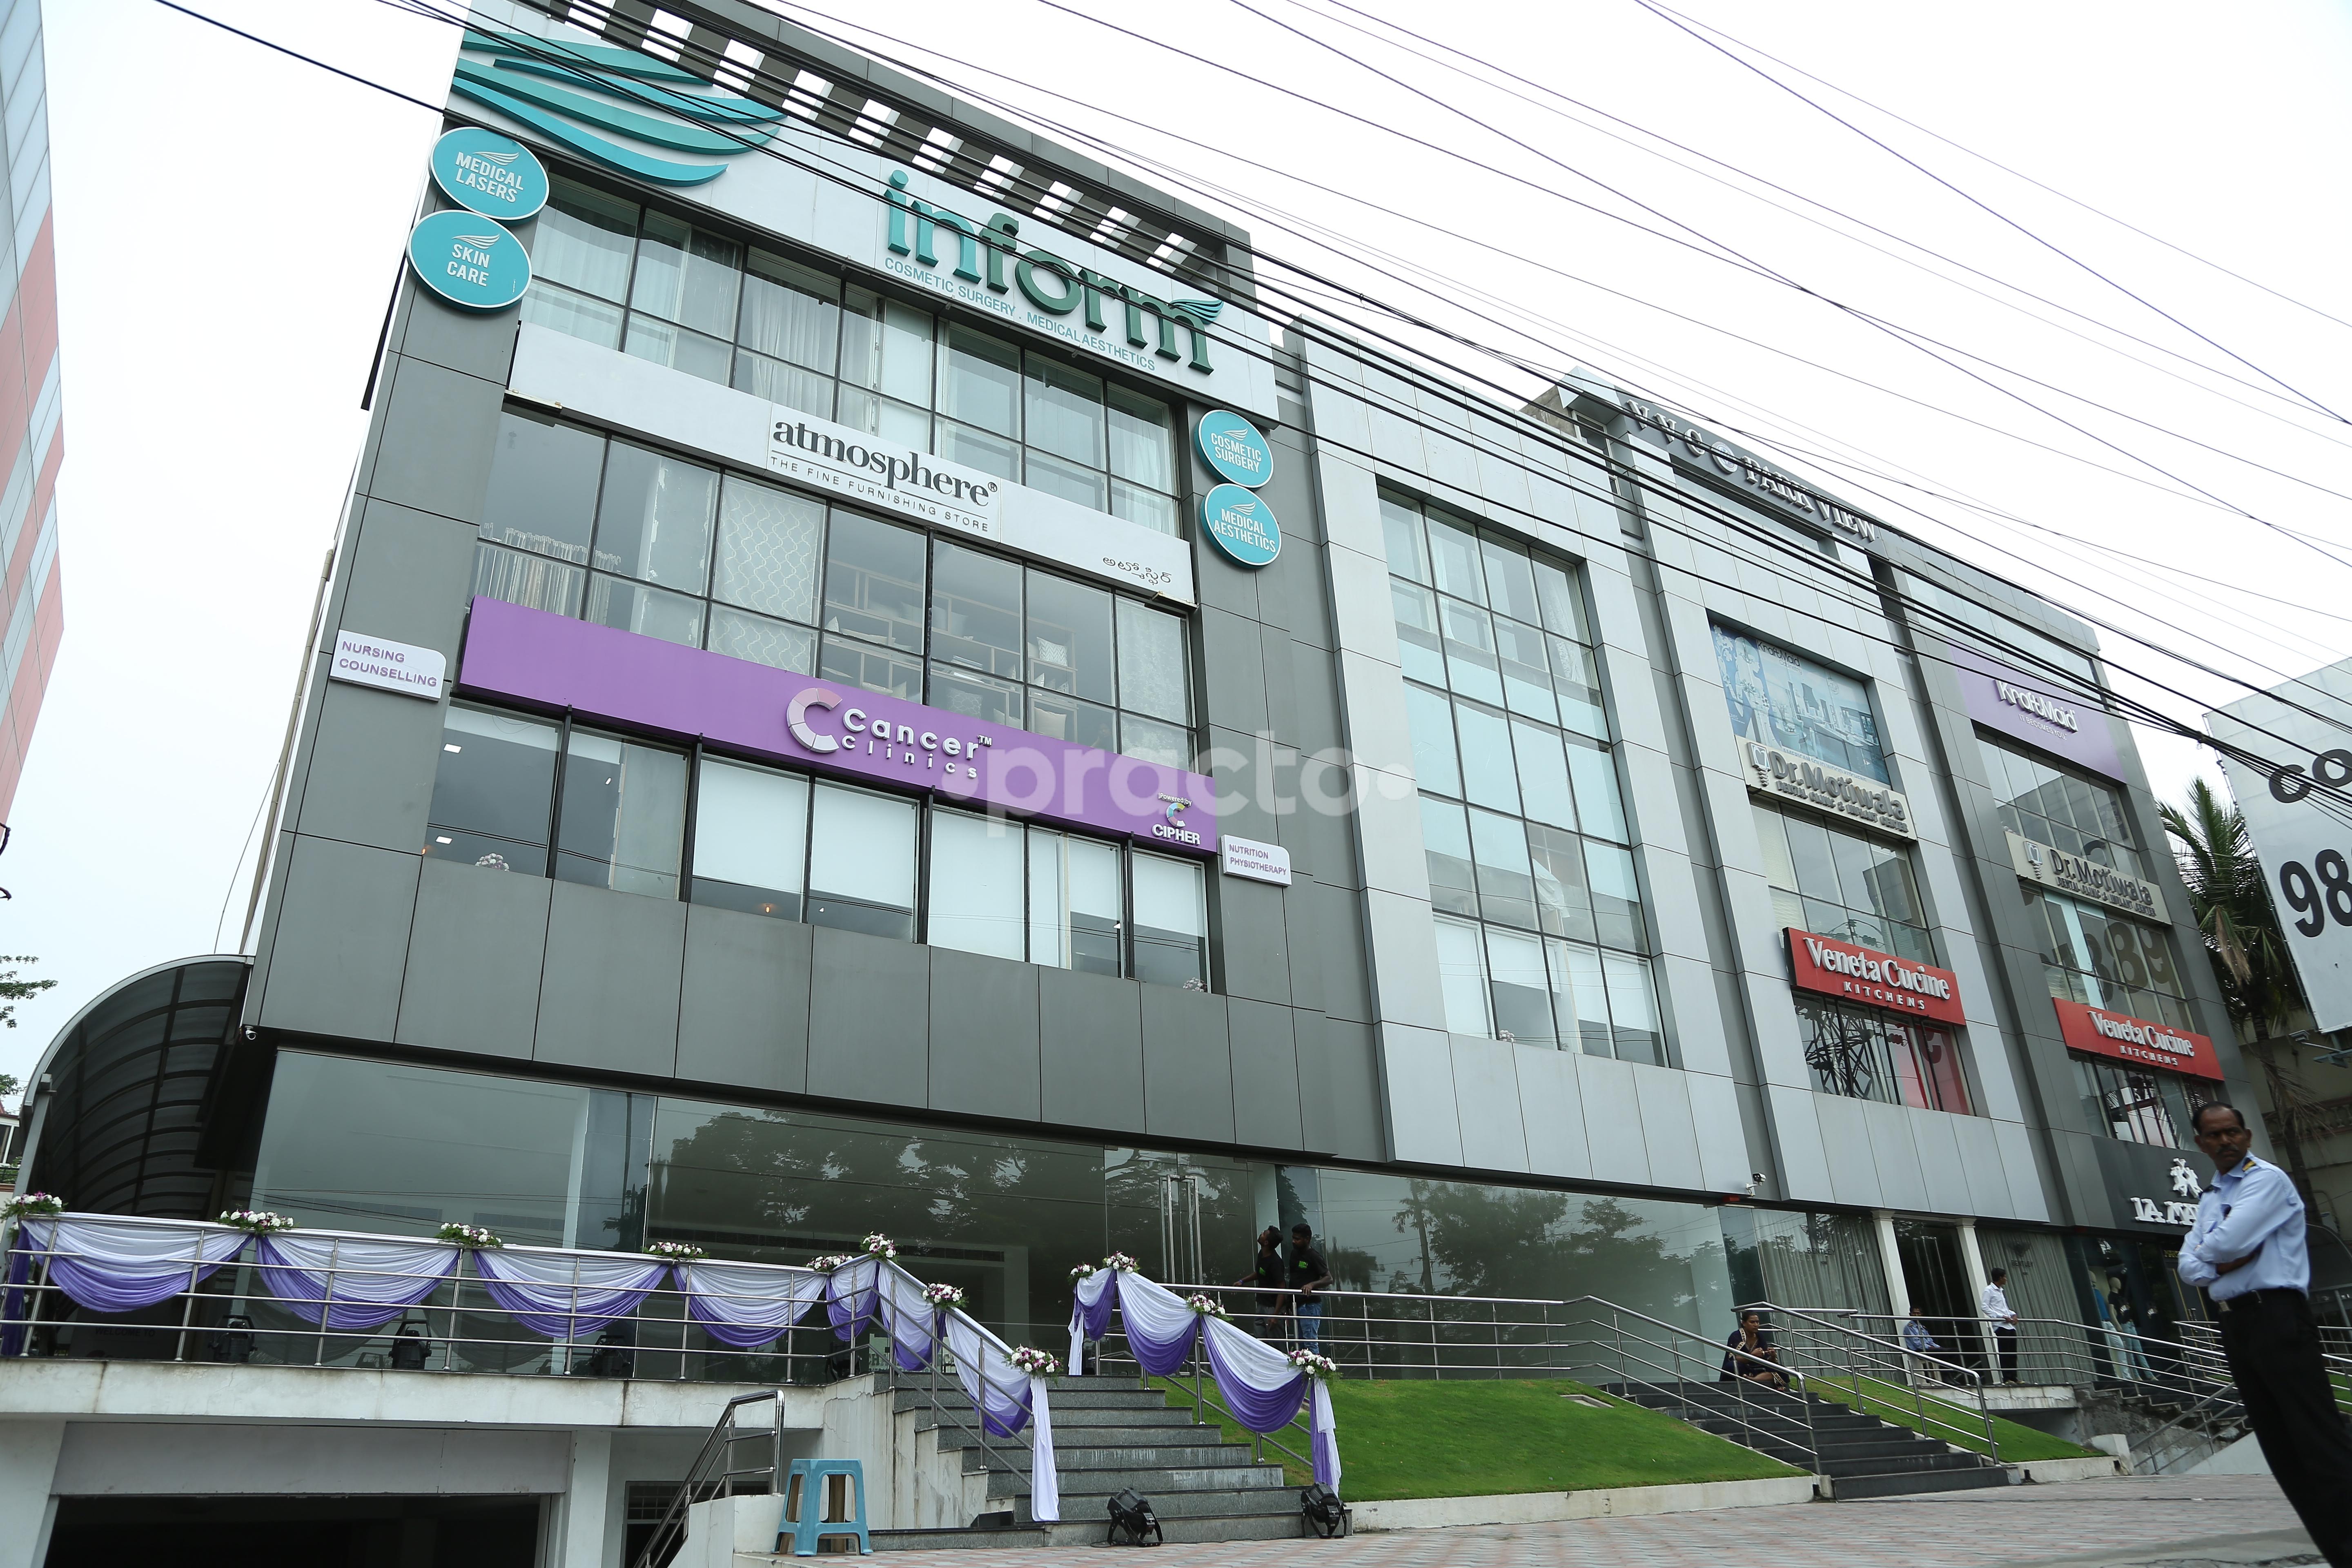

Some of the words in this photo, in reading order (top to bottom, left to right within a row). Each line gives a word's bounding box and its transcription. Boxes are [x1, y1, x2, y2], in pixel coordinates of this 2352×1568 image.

[455, 151, 524, 190] MEDICAL
[456, 168, 517, 203] LASERS
[452, 244, 490, 268] SKIN
[447, 261, 489, 287] CARE
[884, 169, 1214, 375] inform
[885, 257, 954, 293] COSMETIC
[958, 285, 1016, 316] SURGERY
[1211, 432, 1261, 462] COSMETIC
[1215, 446, 1261, 473] SURGERY
[771, 457, 799, 472] THE
[807, 468, 840, 486] FINE
[848, 481, 936, 516] FURNISHING
[945, 511, 988, 532] STORE
[1221, 508, 1266, 536] MEDICAL
[1816, 499, 1875, 542] VIEW
[1213, 520, 1276, 553] AESTHETICS
[341, 640, 405, 663] NURSING
[1757, 640, 1801, 667] KraftMaid
[339, 658, 437, 687] COUNSELLING
[2025, 717, 2054, 734] BECOMES
[1160, 792, 1184, 803] Powered
[1185, 798, 1192, 806] by
[1776, 780, 1808, 800] DENTAL
[1809, 791, 1836, 808] CLINIC
[1837, 801, 1845, 811] &
[1846, 804, 1878, 823] IMPLANT
[1152, 824, 1200, 846] CIPHER
[1228, 844, 1269, 860] NUTRITION
[1230, 857, 1287, 875] PHYSIOTHERAPY
[2056, 876, 2080, 892] DENTAL
[2081, 884, 2101, 899] CLINIC
[2279, 844, 2352, 938] 98
[1803, 937, 1882, 982] Veneta
[1881, 959, 1950, 1000] Cucine
[1843, 981, 1925, 1010] KITCHENS
[2087, 1011, 2145, 1045] Veneta
[2143, 1025, 2195, 1057] Cucine
[2120, 1045, 2178, 1066] KITCHENS
[1806, 1247, 1835, 1255] BENTLEY
[95, 1327, 141, 1336] WELCOME
[144, 1329, 156, 1337] TO
